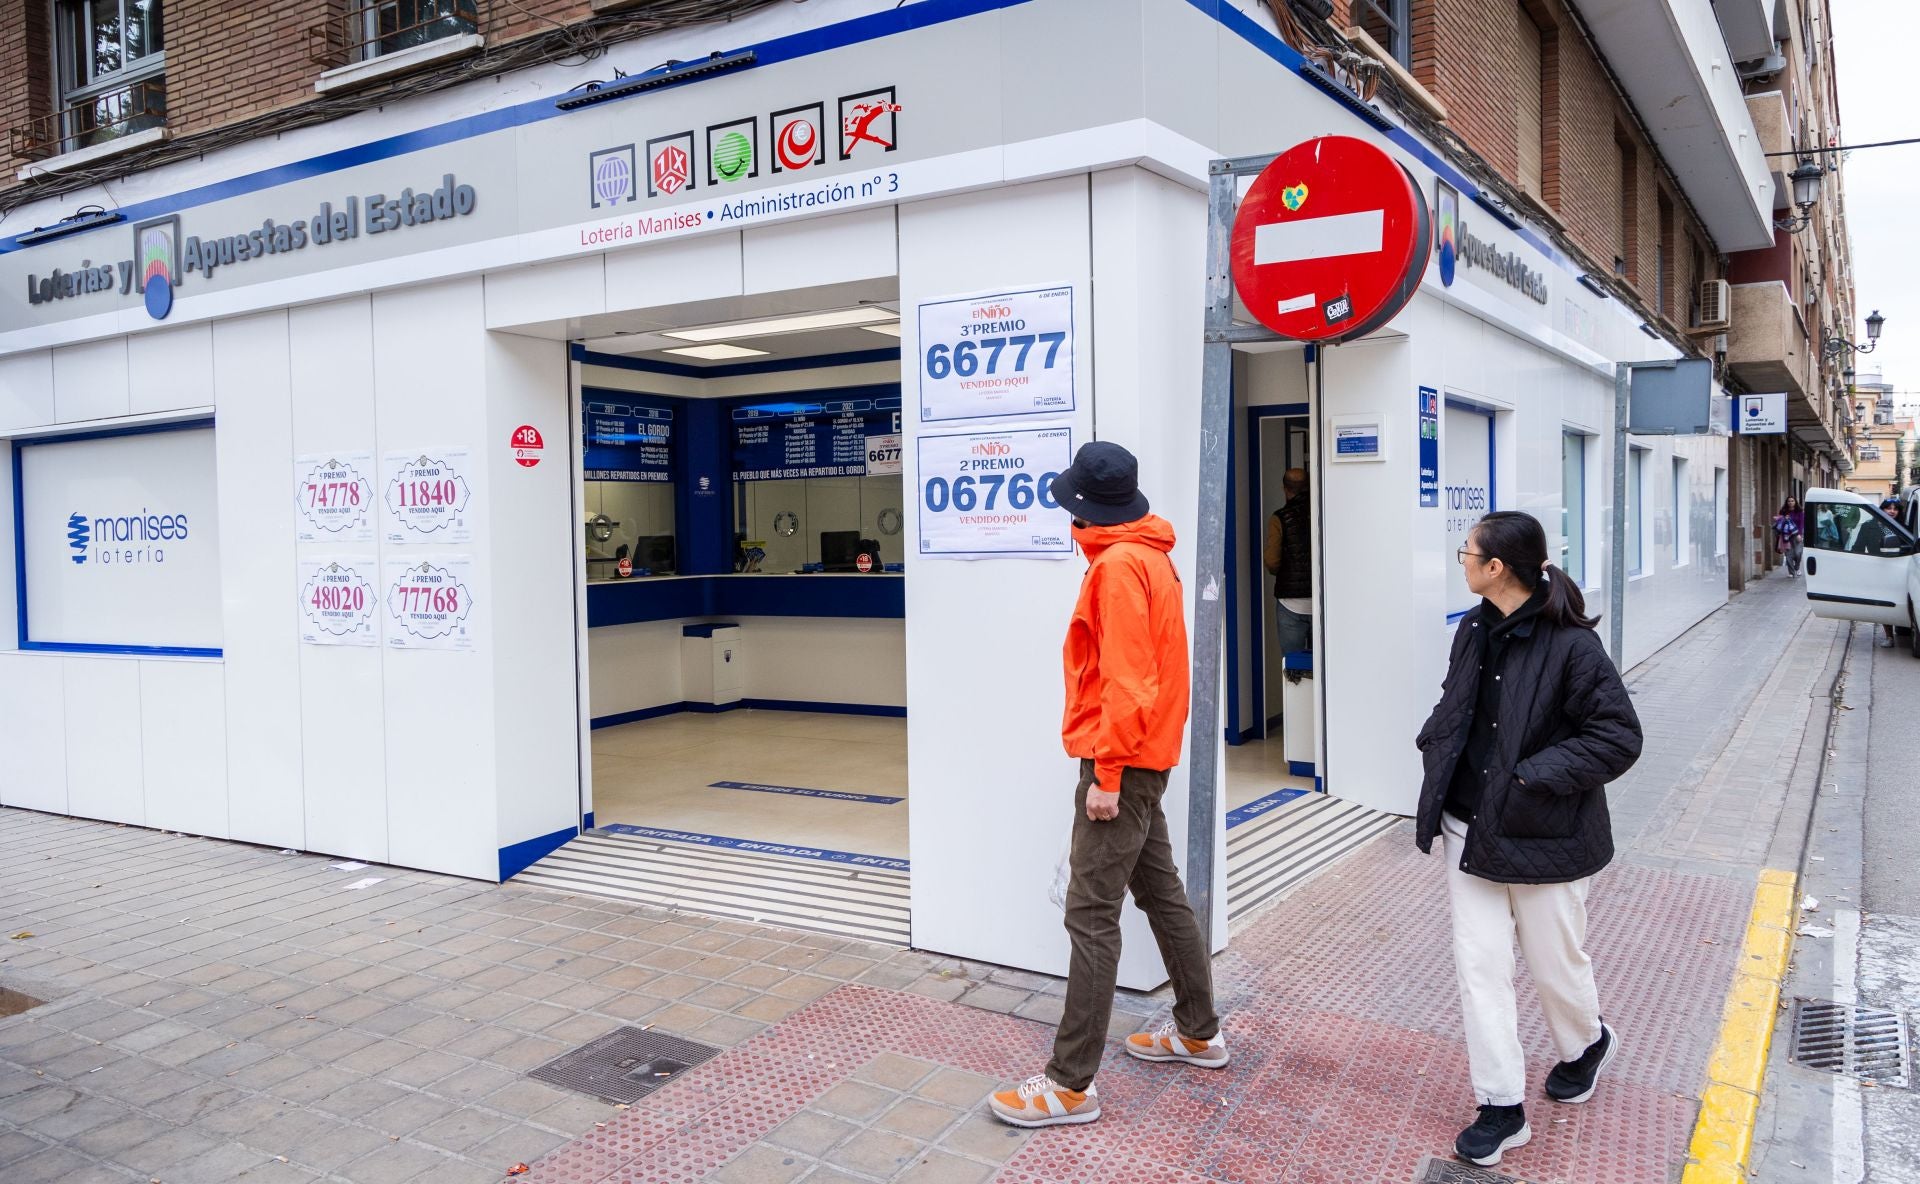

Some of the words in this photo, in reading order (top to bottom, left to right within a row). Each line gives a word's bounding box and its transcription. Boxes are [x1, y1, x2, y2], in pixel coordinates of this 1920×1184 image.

[581, 222, 633, 246] Lotería
[638, 210, 702, 237] Manises
[720, 182, 855, 222] Administración
[888, 173, 899, 193] 3
[28, 259, 114, 305] Loterías
[118, 260, 134, 295] y
[183, 218, 308, 279] Apuestas
[310, 196, 359, 246] del
[364, 173, 476, 234] Estado
[1460, 221, 1506, 279] Apuestas
[972, 310, 980, 319] El
[980, 304, 1012, 320] Niño
[972, 319, 1026, 335] PREMIO
[926, 331, 1066, 380] 66777
[960, 378, 1002, 390] VENDIDO
[842, 402, 854, 411] 2021
[516, 428, 537, 444] +18
[638, 423, 647, 436] EL
[647, 424, 670, 437] GORDO
[972, 446, 979, 454] El
[979, 441, 1010, 456] Niño
[972, 458, 1025, 470] PREMIO
[324, 470, 347, 480] PREMIO
[414, 468, 440, 478] PREMIO
[584, 470, 610, 480] MILLONES
[610, 471, 640, 480] REPARTIDOS
[640, 472, 648, 480] EN
[648, 472, 668, 481] PREMIOS
[732, 472, 740, 480] EL
[740, 470, 760, 480] PUEBLO
[760, 470, 771, 479] QUE
[771, 468, 783, 478] MÁS
[783, 468, 800, 478] VECES
[800, 468, 808, 478] HA
[808, 466, 838, 477] REPARTIDO
[838, 466, 846, 476] EL
[846, 465, 865, 476] GORDO
[308, 480, 360, 508] 74778
[398, 480, 456, 506] 11840
[925, 472, 1060, 512] 06766
[94, 507, 188, 542] manises
[960, 515, 1001, 524] VENDIDO
[96, 544, 164, 564] lotería
[312, 586, 364, 610] 48020
[398, 586, 458, 613] 77768
[1242, 799, 1282, 814] SALIDA
[634, 828, 712, 844] ENTRADA
[737, 842, 822, 858] ENTRADA
